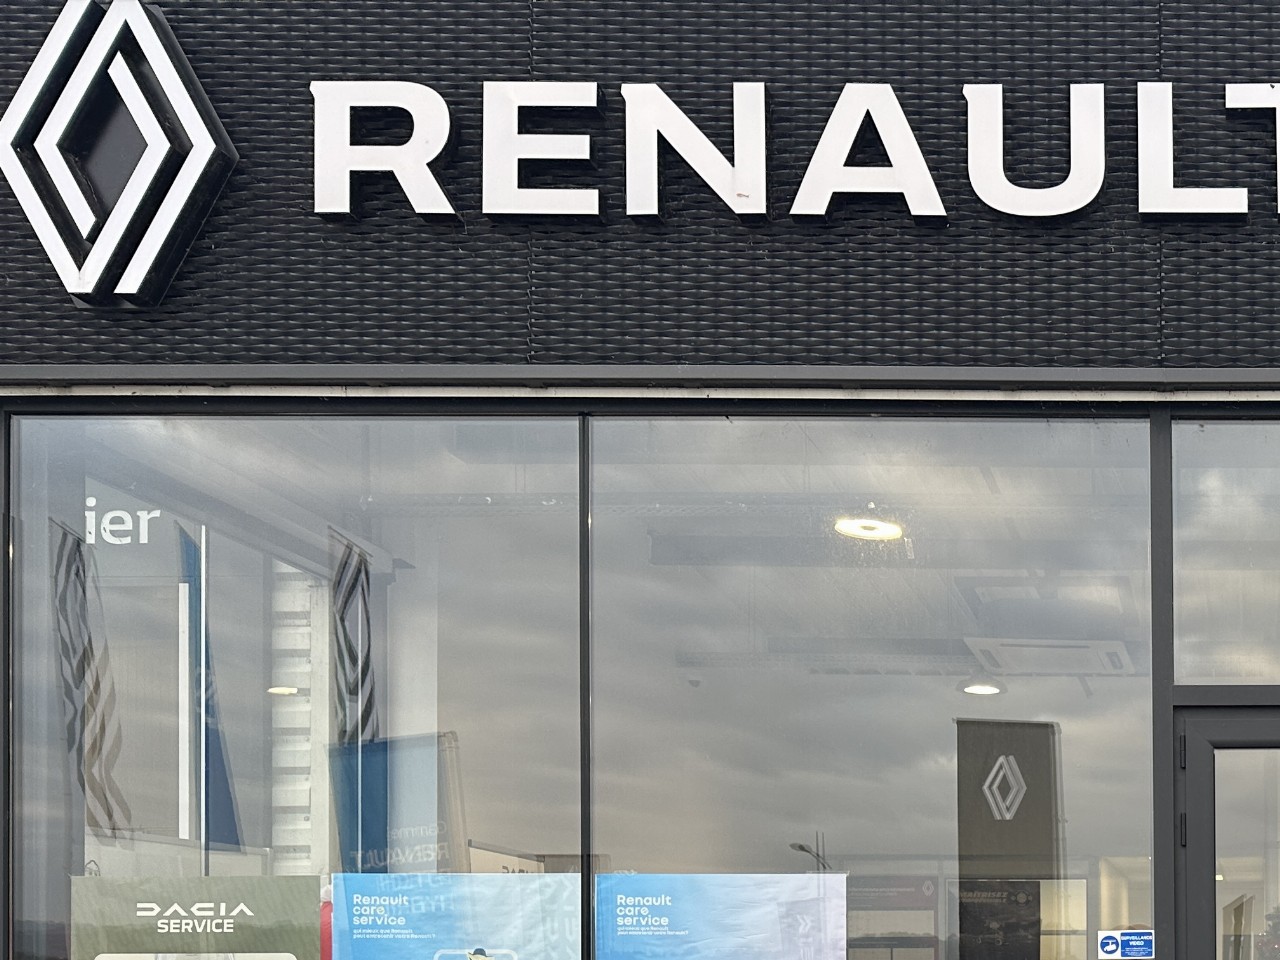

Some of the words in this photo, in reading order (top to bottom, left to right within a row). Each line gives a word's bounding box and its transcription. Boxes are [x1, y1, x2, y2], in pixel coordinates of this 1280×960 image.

[84, 497, 161, 545] ier
[353, 893, 409, 905] Renault
[616, 894, 672, 906] Renault
[136, 902, 255, 917] DACIA
[353, 906, 385, 915] care
[616, 907, 649, 916] care
[353, 914, 406, 925] service
[616, 915, 669, 925] service
[157, 919, 234, 933] SERVICE
